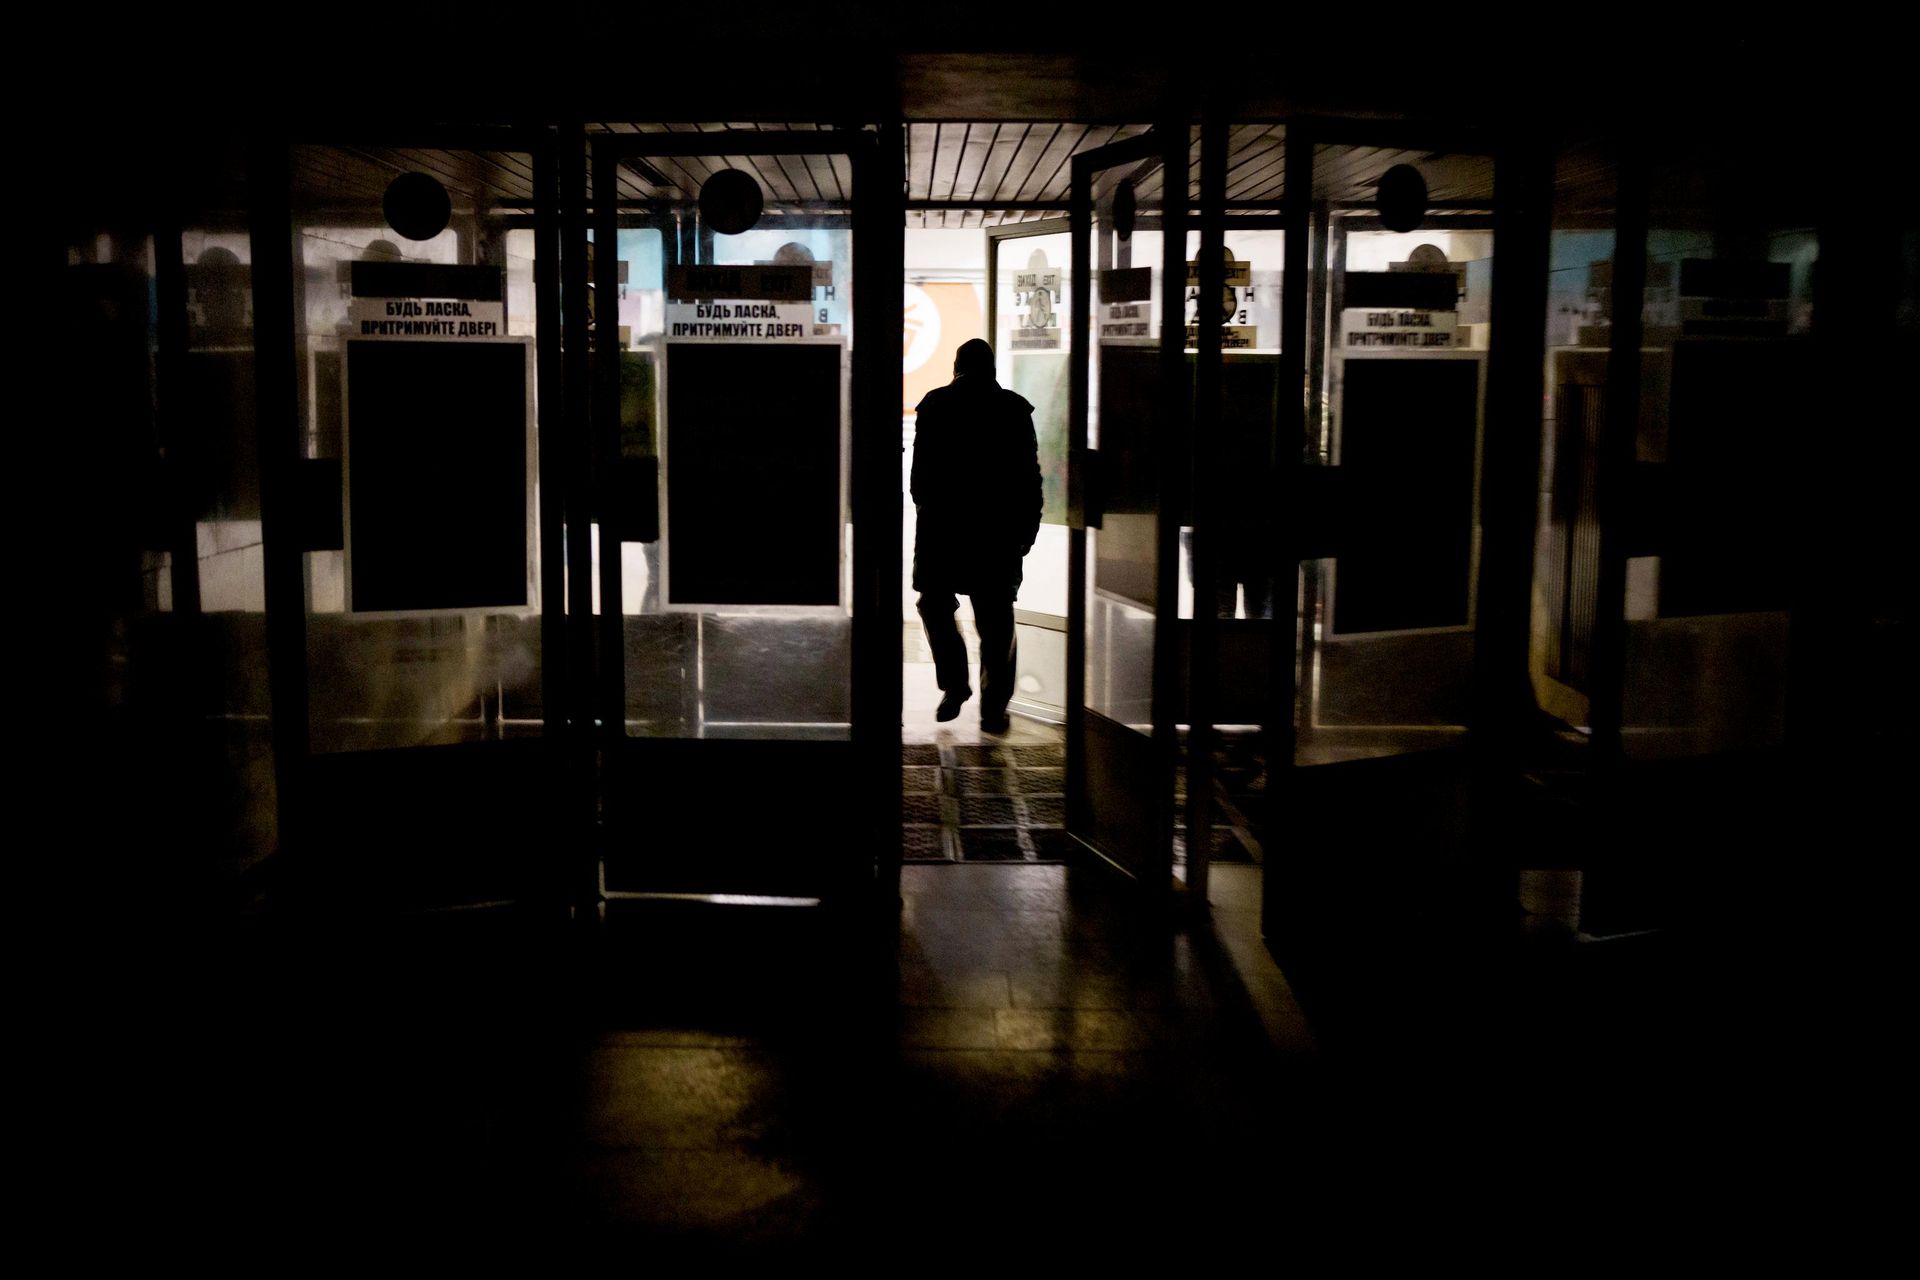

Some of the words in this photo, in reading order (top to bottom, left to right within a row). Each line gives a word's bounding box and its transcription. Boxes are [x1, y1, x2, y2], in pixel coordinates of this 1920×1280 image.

[386, 302, 421, 316] БУДЬ
[425, 302, 472, 317] ЛАСКА,
[696, 305, 731, 319] БУДЬ
[734, 305, 780, 319] ЛАСКА,
[361, 319, 454, 335] ПРИТРИМУЙТЕ
[458, 322, 496, 336] ДВЕРІ
[672, 321, 762, 337] ПРИТРИМУЙТЕ
[765, 324, 803, 338] ДВЕРІ
